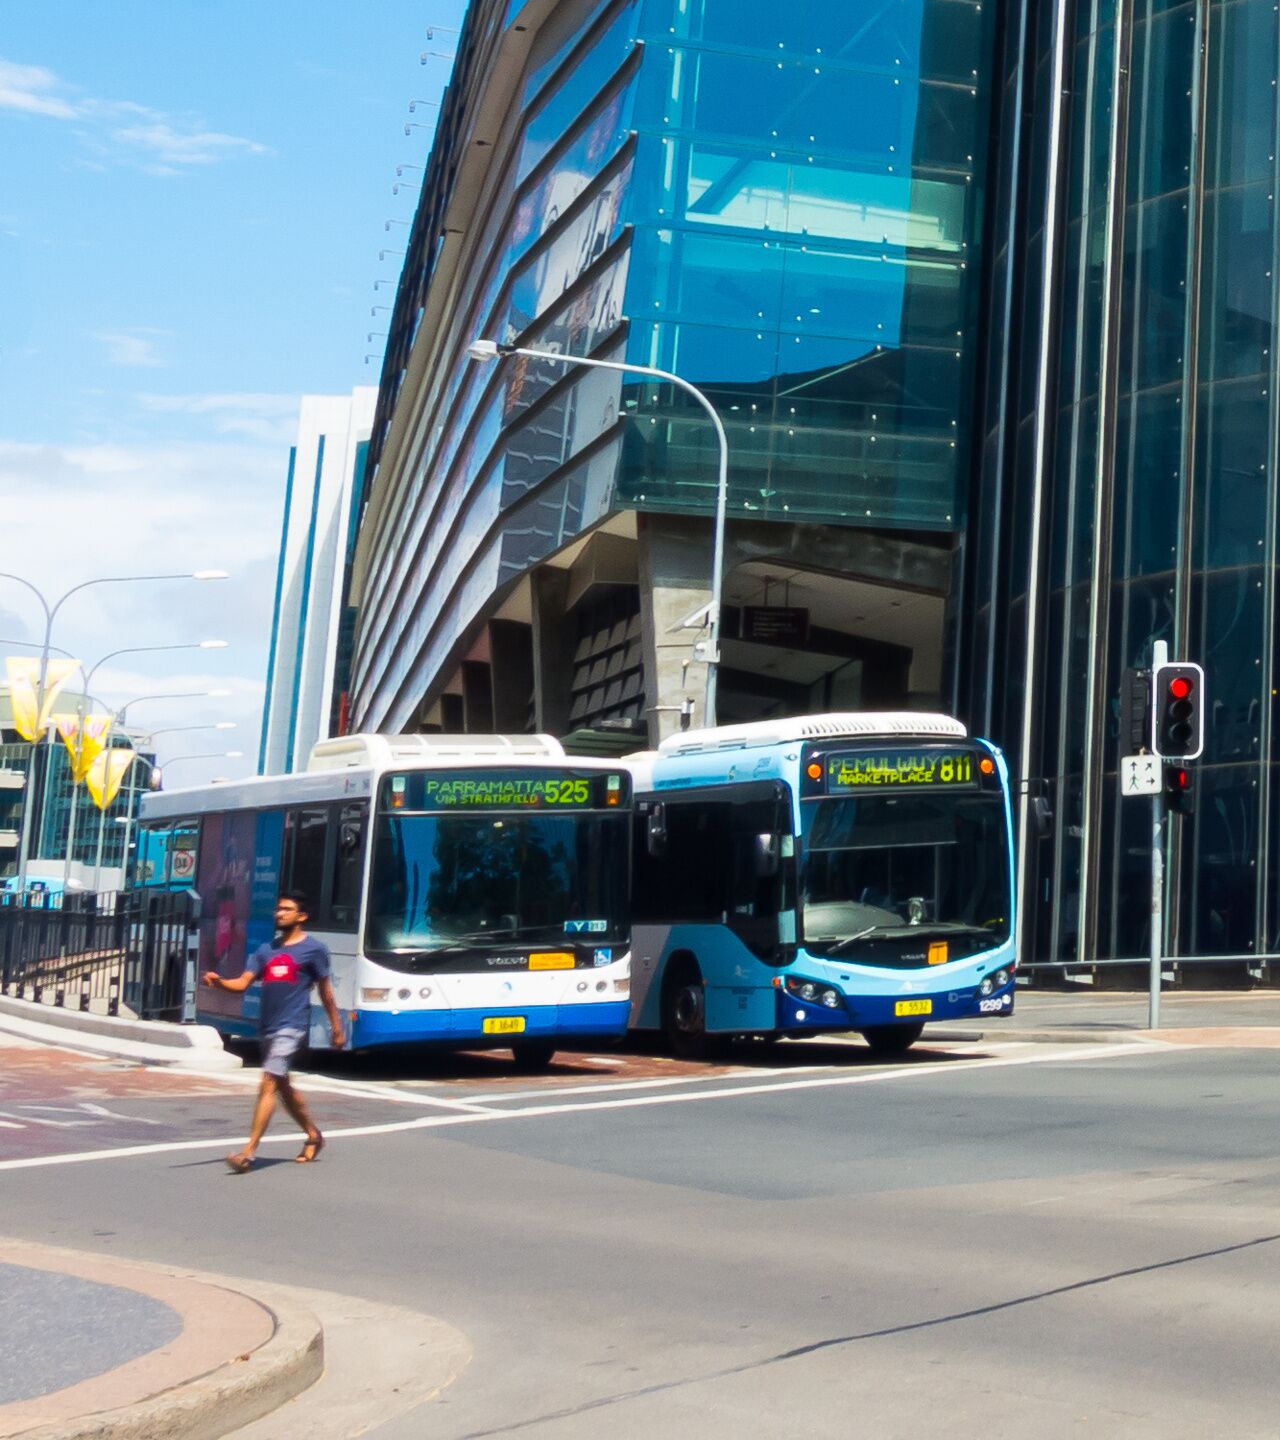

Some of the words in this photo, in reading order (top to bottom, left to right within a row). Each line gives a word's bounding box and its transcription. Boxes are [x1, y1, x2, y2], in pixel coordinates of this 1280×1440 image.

[940, 755, 971, 782] 811
[837, 770, 933, 785] MARKETPLACE
[427, 780, 545, 795] PARRAMATTA
[545, 780, 589, 803] 525
[435, 793, 458, 804] VIA
[461, 793, 539, 804] STRATHFIELD
[487, 957, 527, 965] VOLVO
